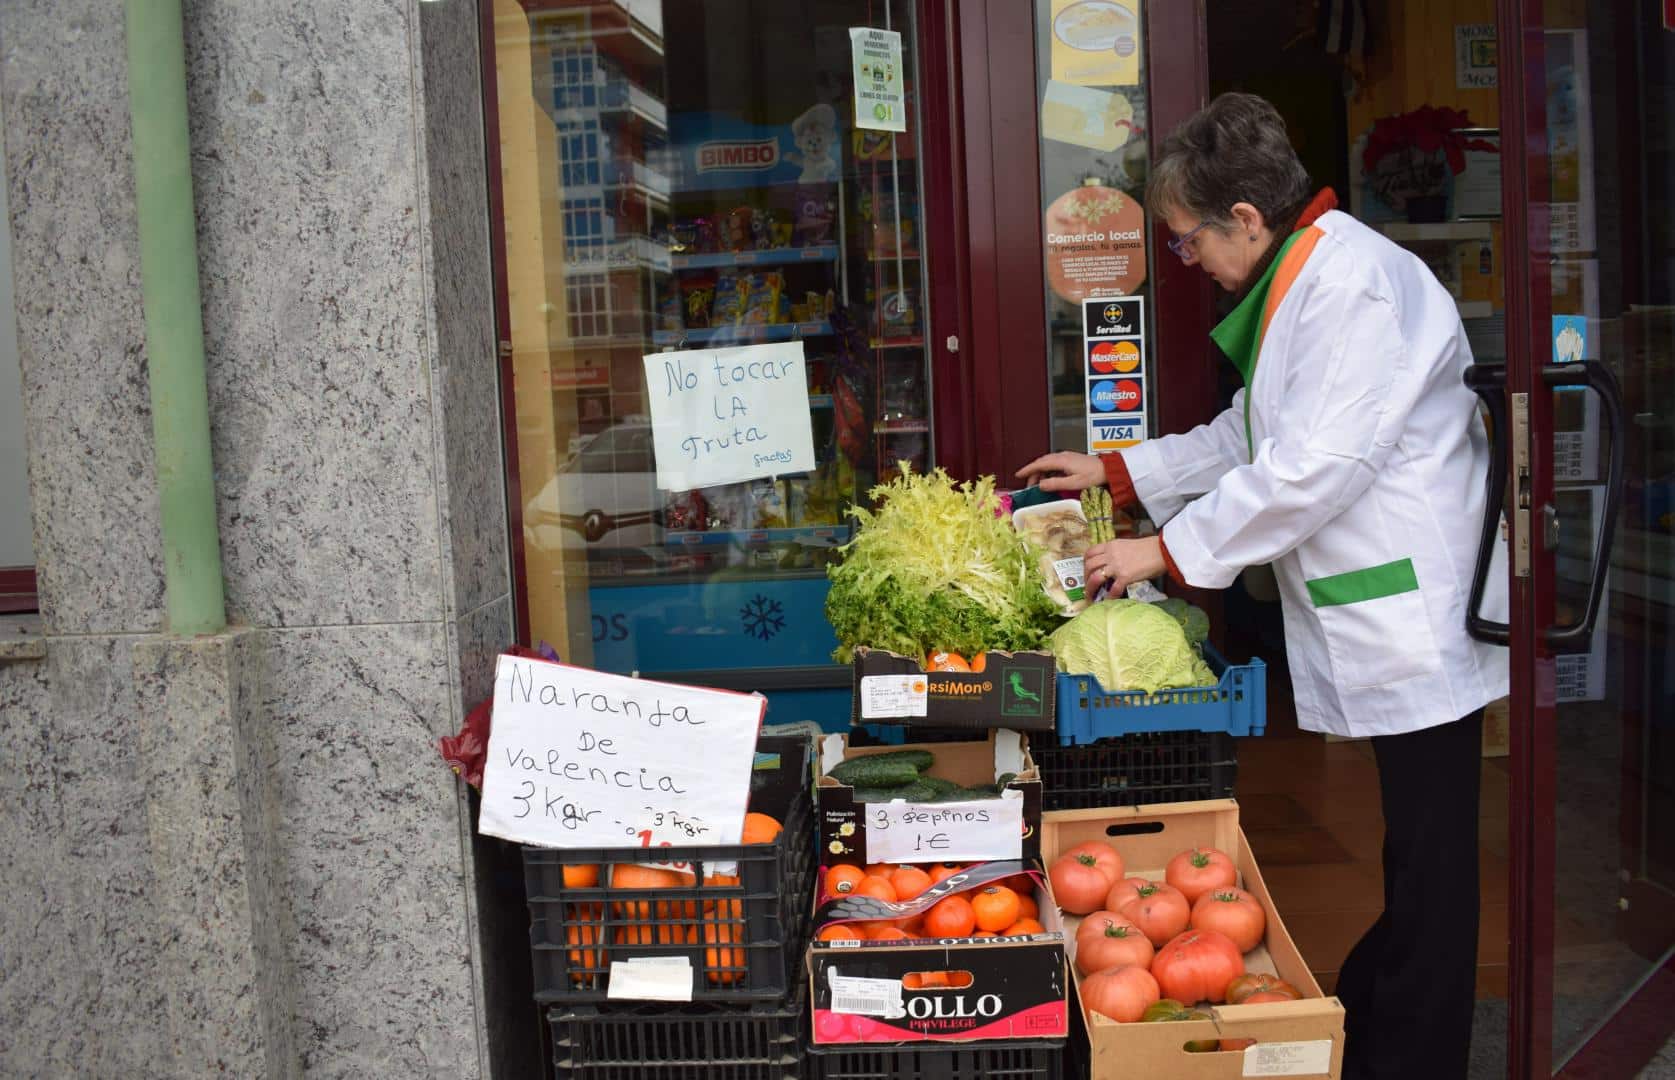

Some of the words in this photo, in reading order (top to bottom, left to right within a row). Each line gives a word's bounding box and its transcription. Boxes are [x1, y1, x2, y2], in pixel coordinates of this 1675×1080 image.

[702, 145, 775, 166] BIMBO
[1047, 231, 1105, 244] Comercio
[1109, 228, 1140, 240] local
[1096, 324, 1131, 335] ServiRed
[1091, 352, 1139, 363] MasterCard
[664, 359, 698, 396] No
[713, 354, 793, 387] tocar
[1096, 390, 1137, 401] Maestro
[1100, 427, 1134, 441] VISA
[510, 662, 706, 727] Naranja
[578, 729, 618, 755] De
[513, 780, 536, 818] 3
[909, 1018, 977, 1030] PRIVILEGE
